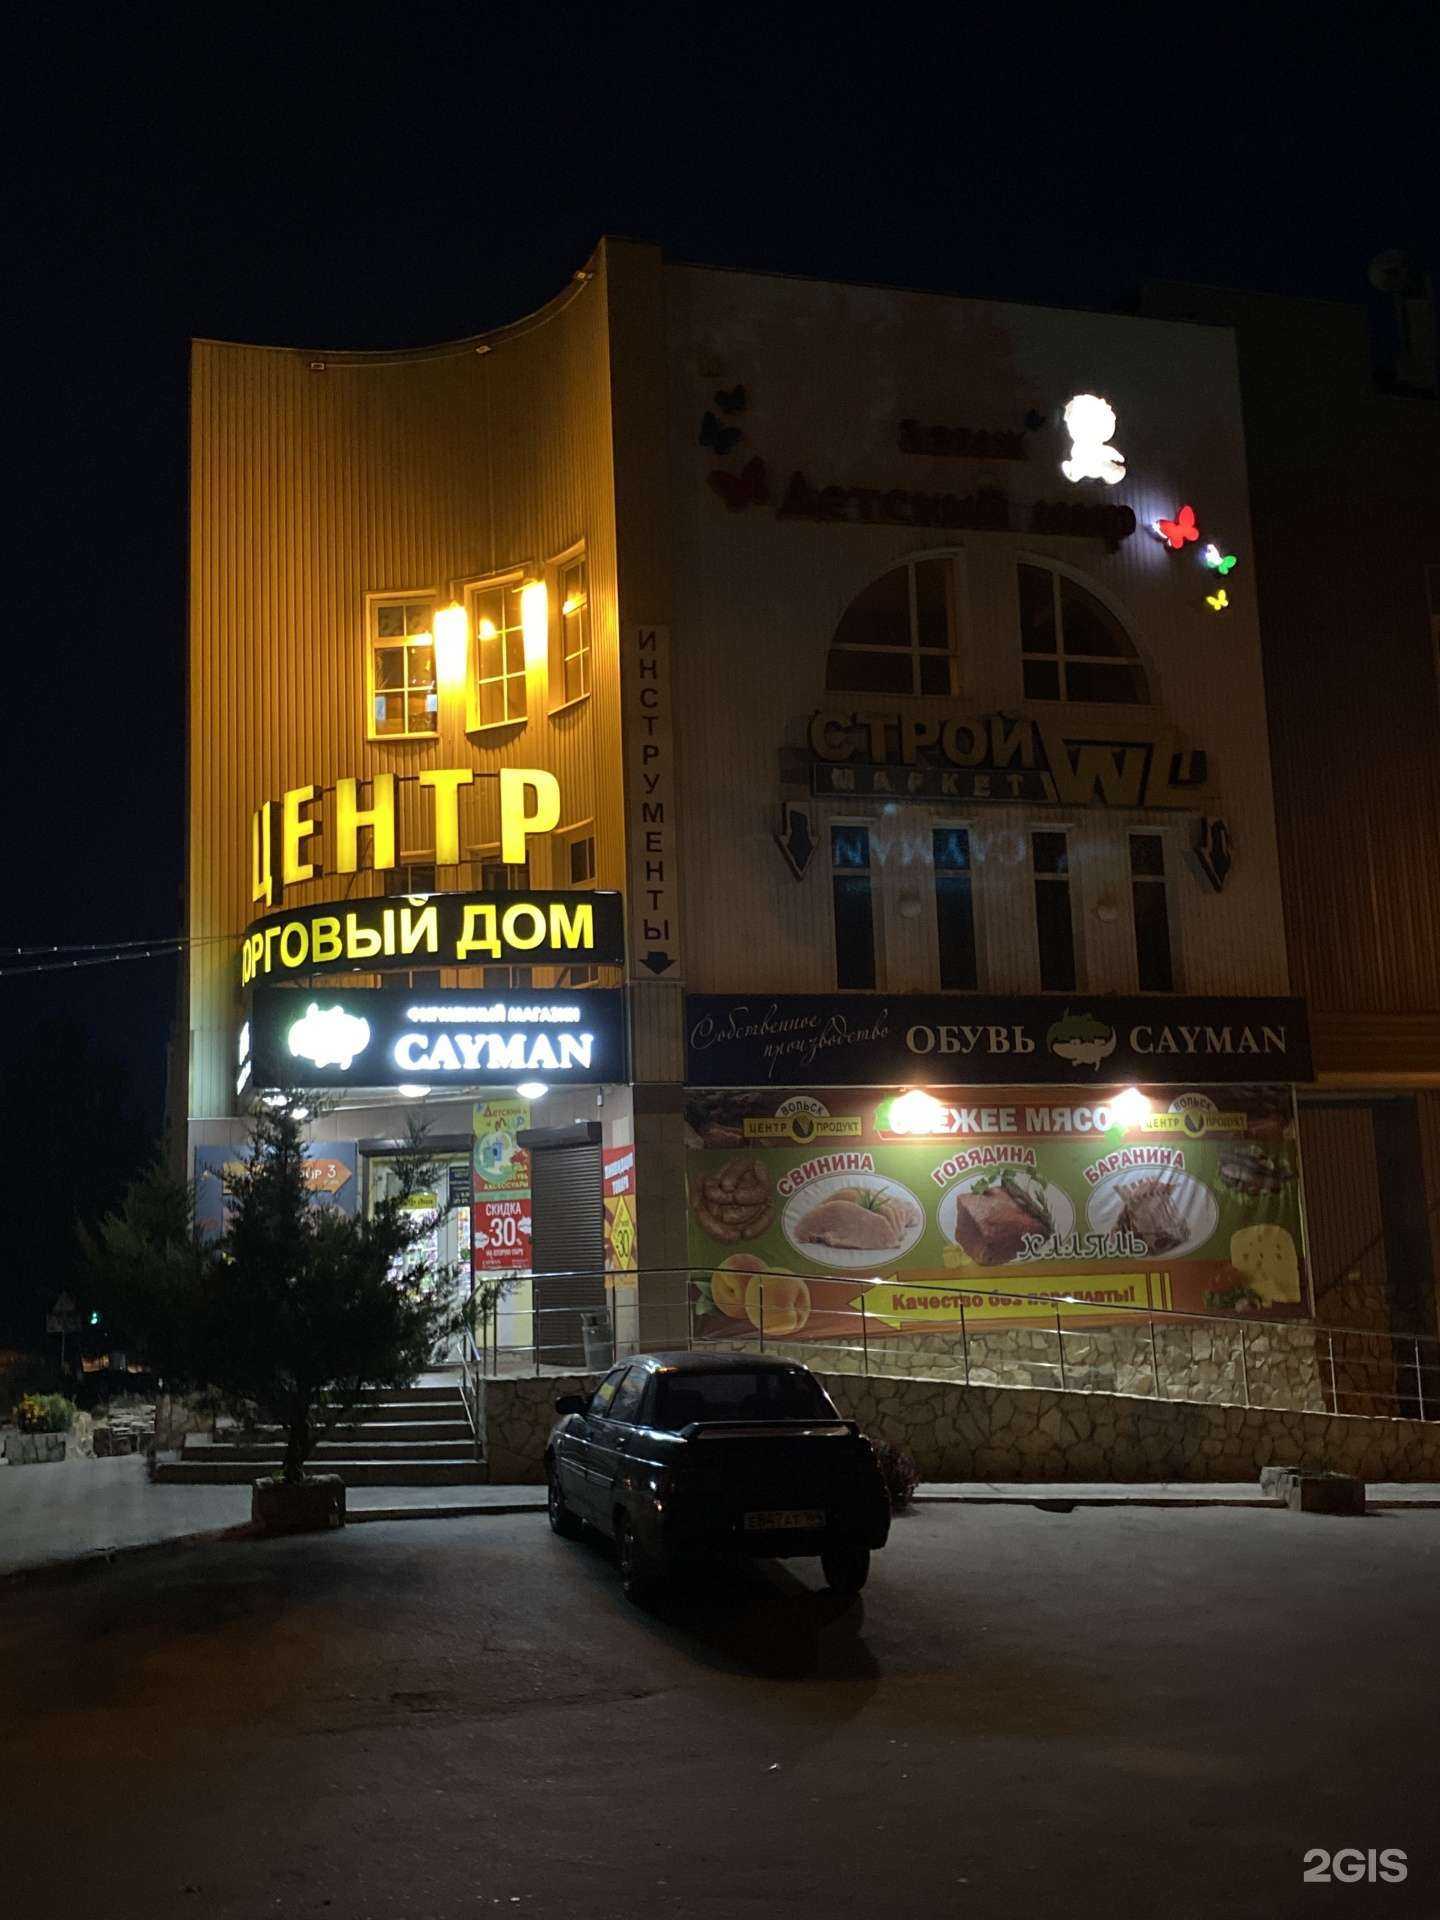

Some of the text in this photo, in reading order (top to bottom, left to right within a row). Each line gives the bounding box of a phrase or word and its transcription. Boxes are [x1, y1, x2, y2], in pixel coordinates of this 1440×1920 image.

[807, 709, 1040, 769] СТРОЙ
[637, 629, 670, 941] ИНСТРУМЕНТЫ
[252, 768, 561, 907] ЦЕНТР
[242, 895, 594, 986] ОРГОВЫЙ ДОМ
[393, 1033, 594, 1070] CAYMAN
[905, 1024, 1036, 1055] ОБУВЬ
[1127, 1024, 1288, 1056] CAYMAN
[750, 1121, 859, 1135] ЦЕНТР ПРОДУКТ
[1025, 1106, 1113, 1133] МЯСО
[777, 1152, 874, 1197] СВИНИНА
[932, 1145, 1036, 1187] ГОВЯДИНА
[1083, 1148, 1185, 1185] БАРАНИНА
[485, 1202, 522, 1217] СКИДКА
[891, 1293, 984, 1312] Качество
